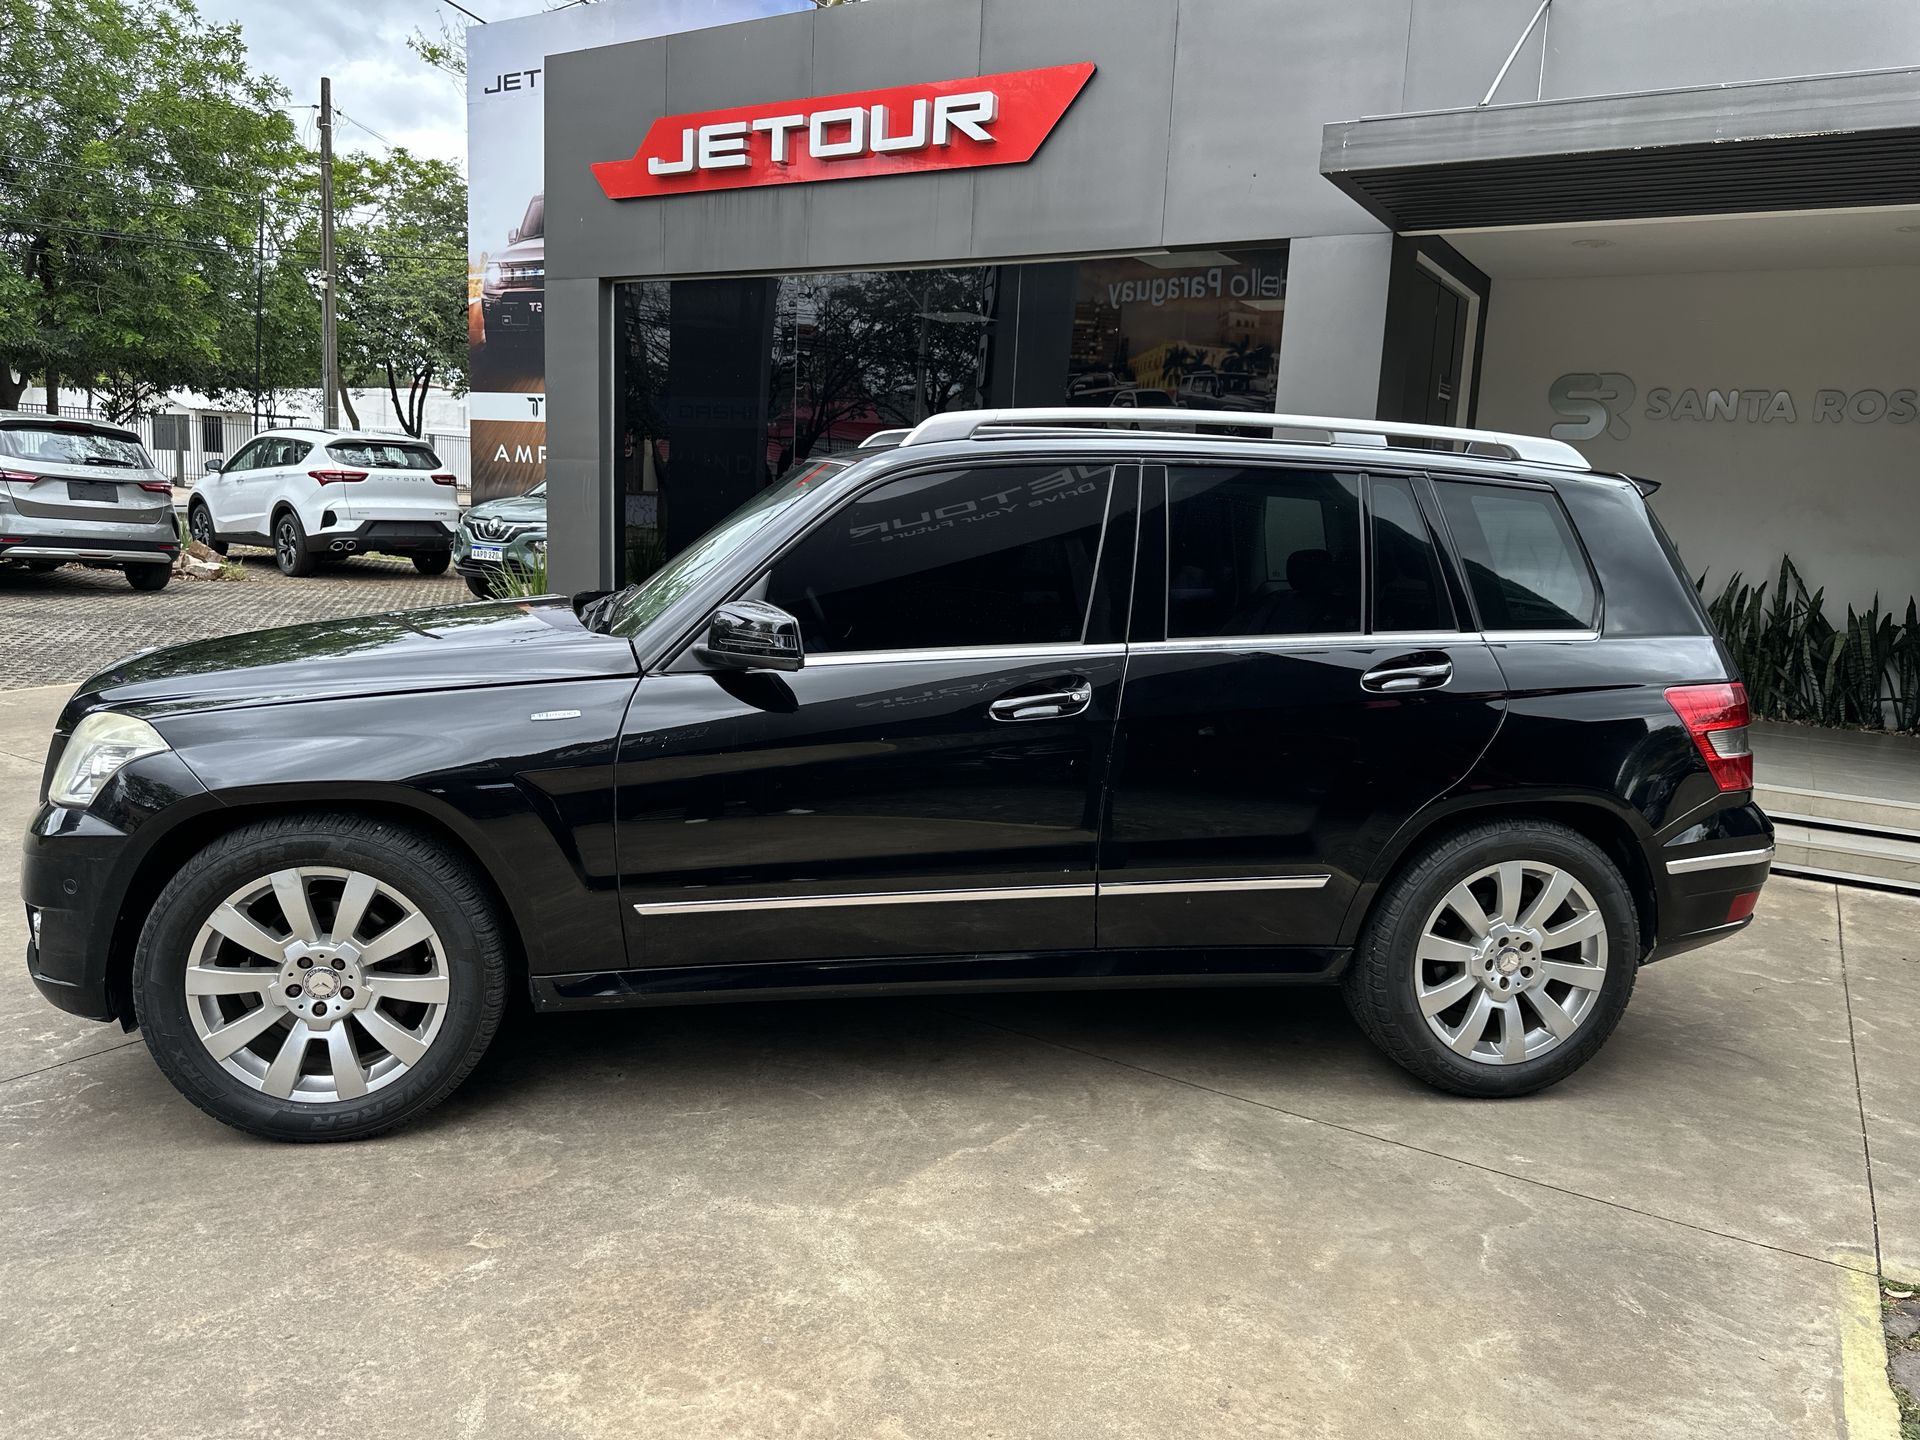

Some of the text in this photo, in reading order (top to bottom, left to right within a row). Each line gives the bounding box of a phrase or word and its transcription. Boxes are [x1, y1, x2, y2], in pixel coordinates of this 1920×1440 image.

[484, 69, 542, 94] JET
[648, 91, 998, 176] JETOUR
[1548, 373, 1636, 441] SR
[1645, 388, 1920, 424] SANTA ROS
